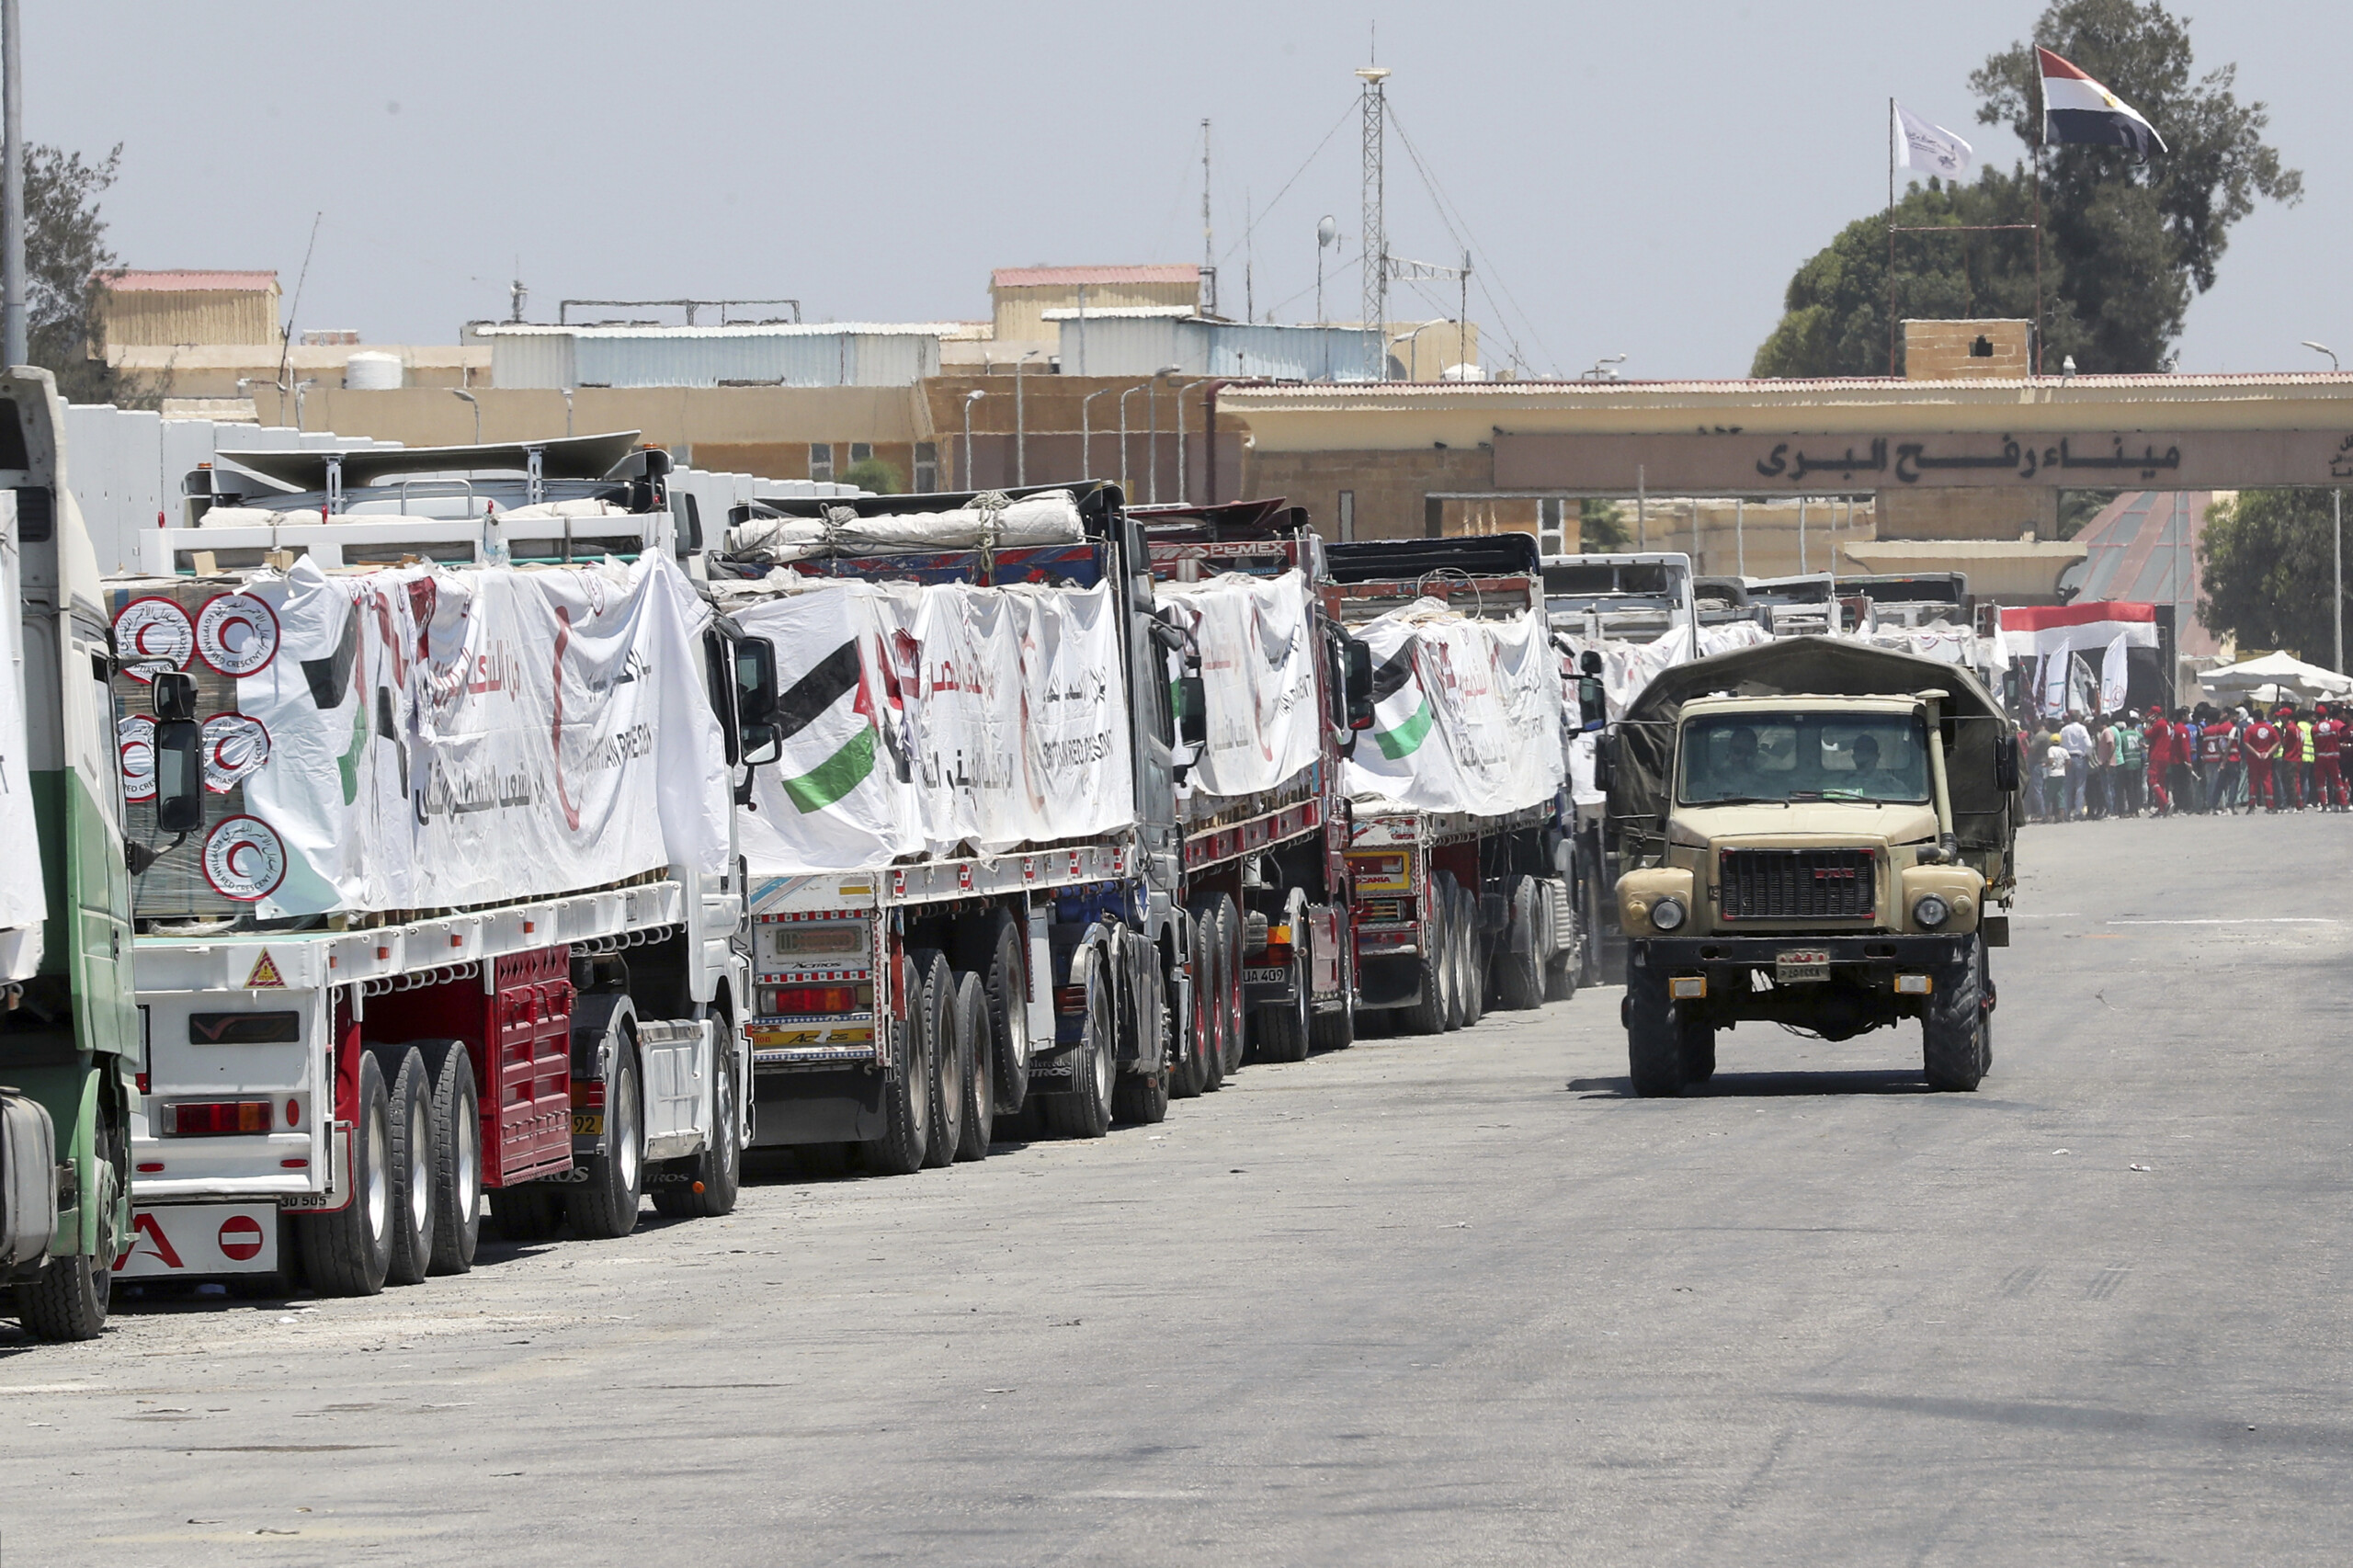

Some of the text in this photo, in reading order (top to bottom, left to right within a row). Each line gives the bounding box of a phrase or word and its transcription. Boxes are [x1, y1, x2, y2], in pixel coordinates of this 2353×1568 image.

[1893, 433, 2037, 483] رفح
[2042, 436, 2181, 480] ميناء
[202, 614, 263, 668] EGYPTIAN RED CRESCENT
[211, 839, 272, 892] EGYPTIAN RED CRESCENT
[1261, 969, 1284, 982] 409
[574, 1116, 596, 1133] 92
[302, 1196, 327, 1206] 505
